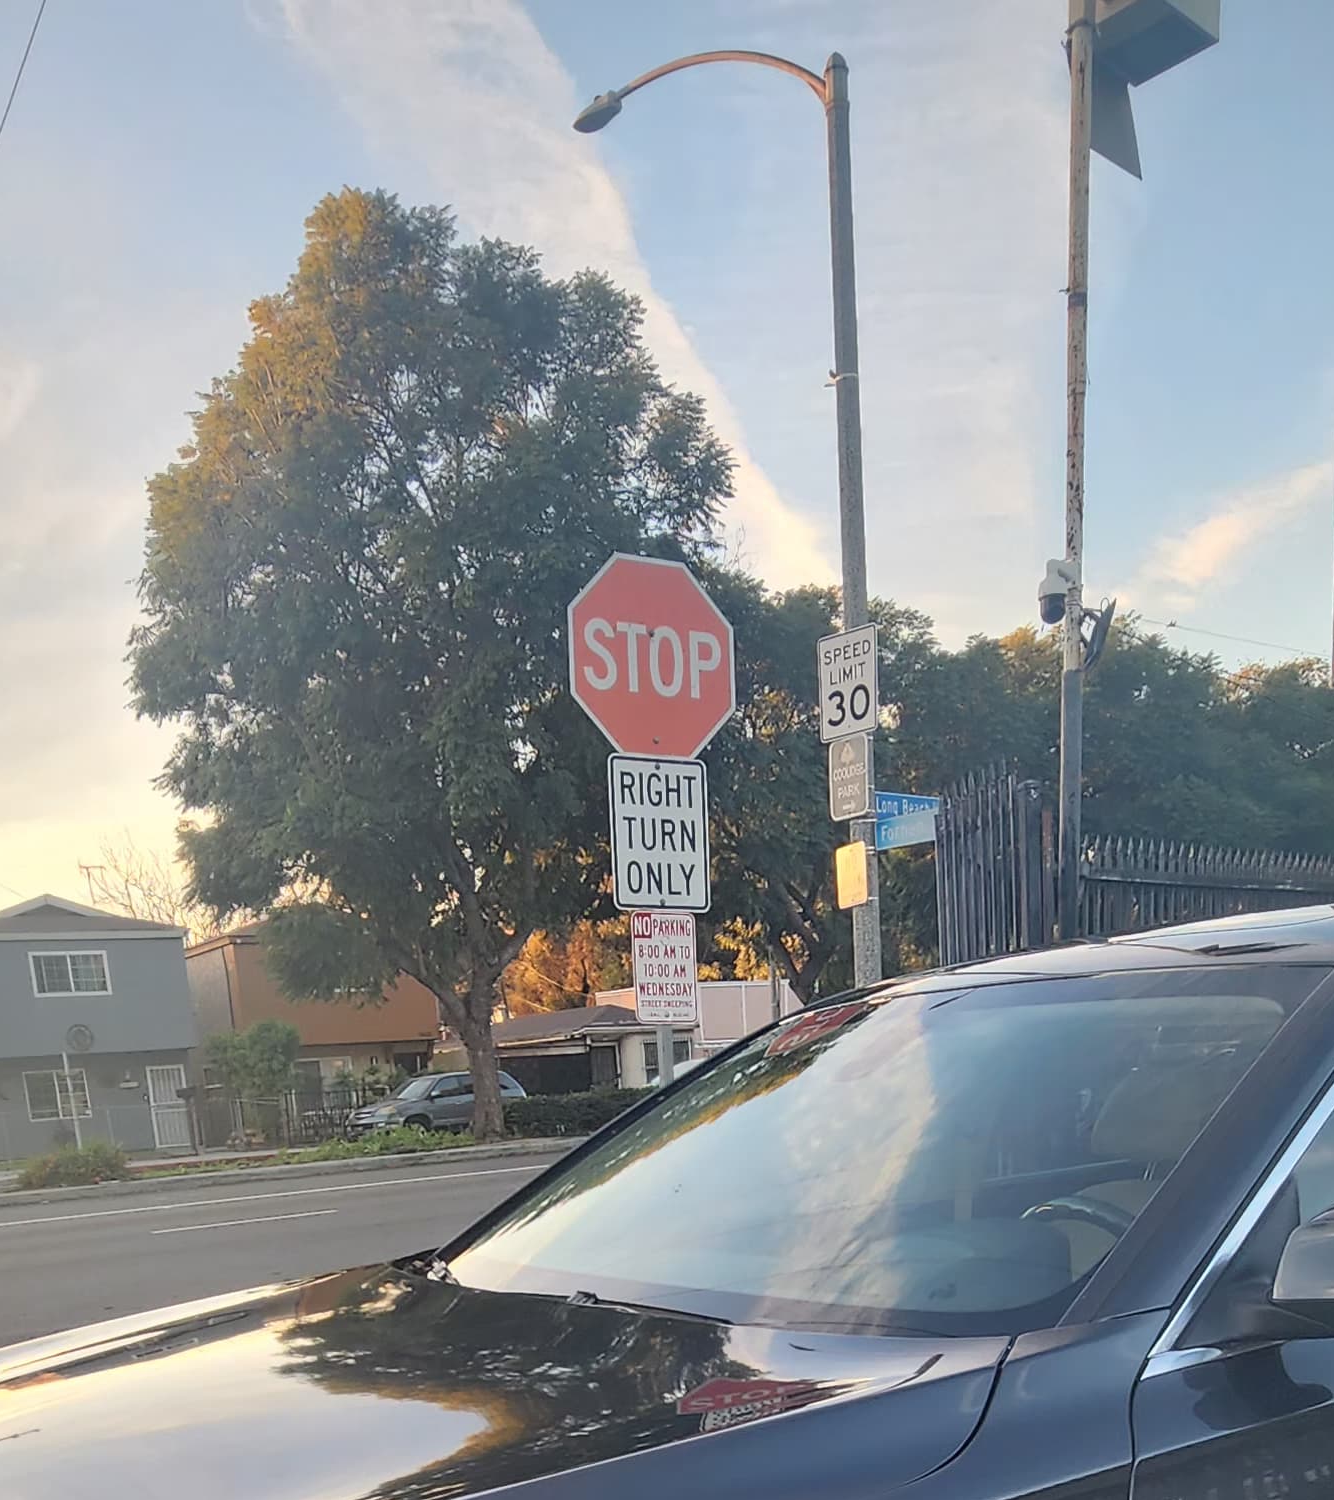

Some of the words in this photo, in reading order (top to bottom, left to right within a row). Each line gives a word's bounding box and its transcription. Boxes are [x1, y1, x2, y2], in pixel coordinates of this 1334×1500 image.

[583, 617, 722, 700] STOP
[824, 640, 871, 666] SPEED
[829, 662, 866, 686] LIMIT
[828, 683, 870, 727] 30
[620, 771, 697, 810] RIGHT
[838, 782, 860, 799] PARK
[875, 796, 898, 816] Long
[622, 816, 697, 854] TURN
[626, 861, 695, 897] ONLY
[634, 915, 651, 936] NO
[652, 918, 691, 937] PARKING
[638, 944, 660, 958] 8:00
[663, 944, 676, 959] AM
[679, 945, 691, 959] TO
[644, 963, 670, 977] 10:00
[673, 964, 687, 978] AM
[639, 982, 693, 997] WEDNESDAY
[641, 1000, 662, 1008] STREET
